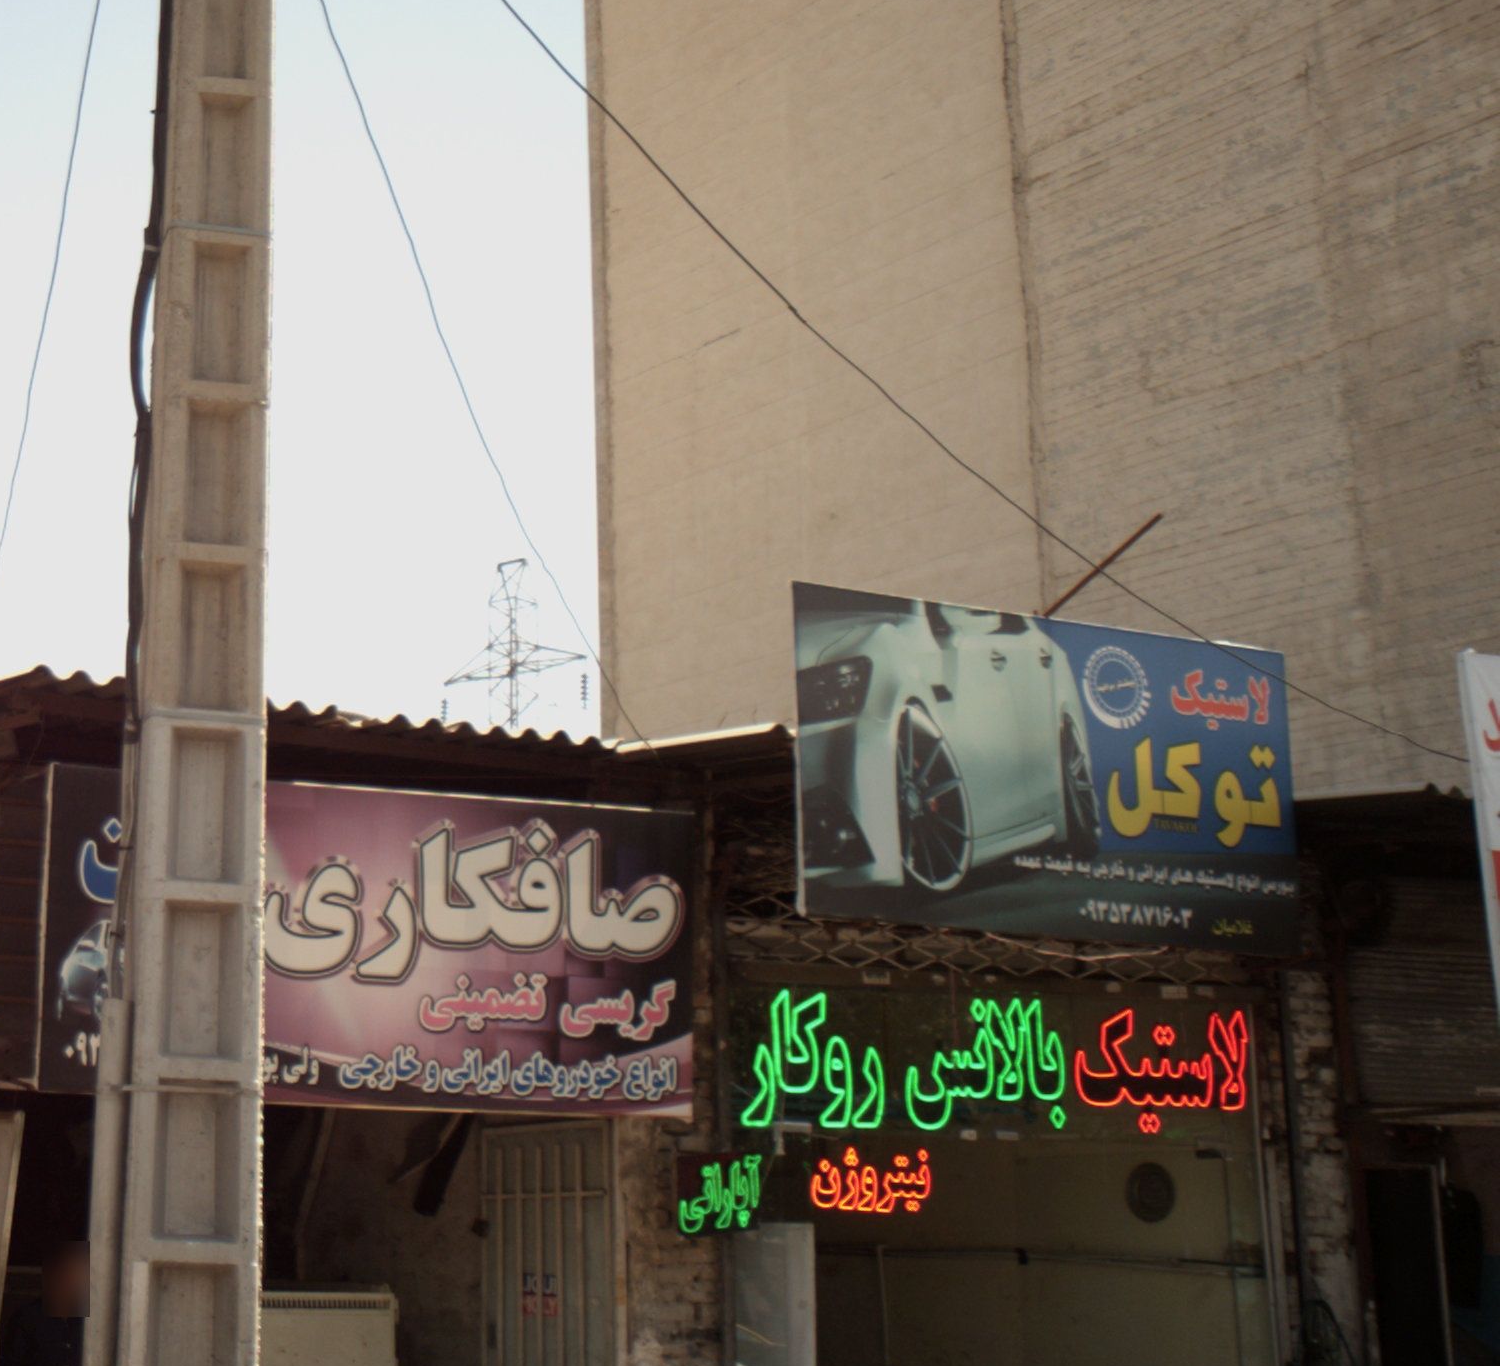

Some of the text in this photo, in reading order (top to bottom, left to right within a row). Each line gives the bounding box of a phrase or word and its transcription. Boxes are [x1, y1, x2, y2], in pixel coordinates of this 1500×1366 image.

[1171, 669, 1270, 730] لاستیک
[1108, 736, 1281, 847] توکل
[1045, 853, 1074, 876] قیمت
[1092, 859, 1125, 880] خارجی
[1128, 866, 1135, 881] و
[1137, 863, 1169, 885] ایرانی
[264, 818, 687, 985] صافکاری
[420, 972, 548, 1031] تضمینی
[337, 1044, 422, 1091] خارجی
[422, 1059, 440, 1093] و
[442, 1048, 510, 1095] ایرانی
[624, 1056, 678, 1101] انواع
[740, 989, 1248, 1133] لاستیک بالانس روکار
[679, 1153, 762, 1233] آپاراتی
[810, 1146, 931, 1213] نیتروژن
